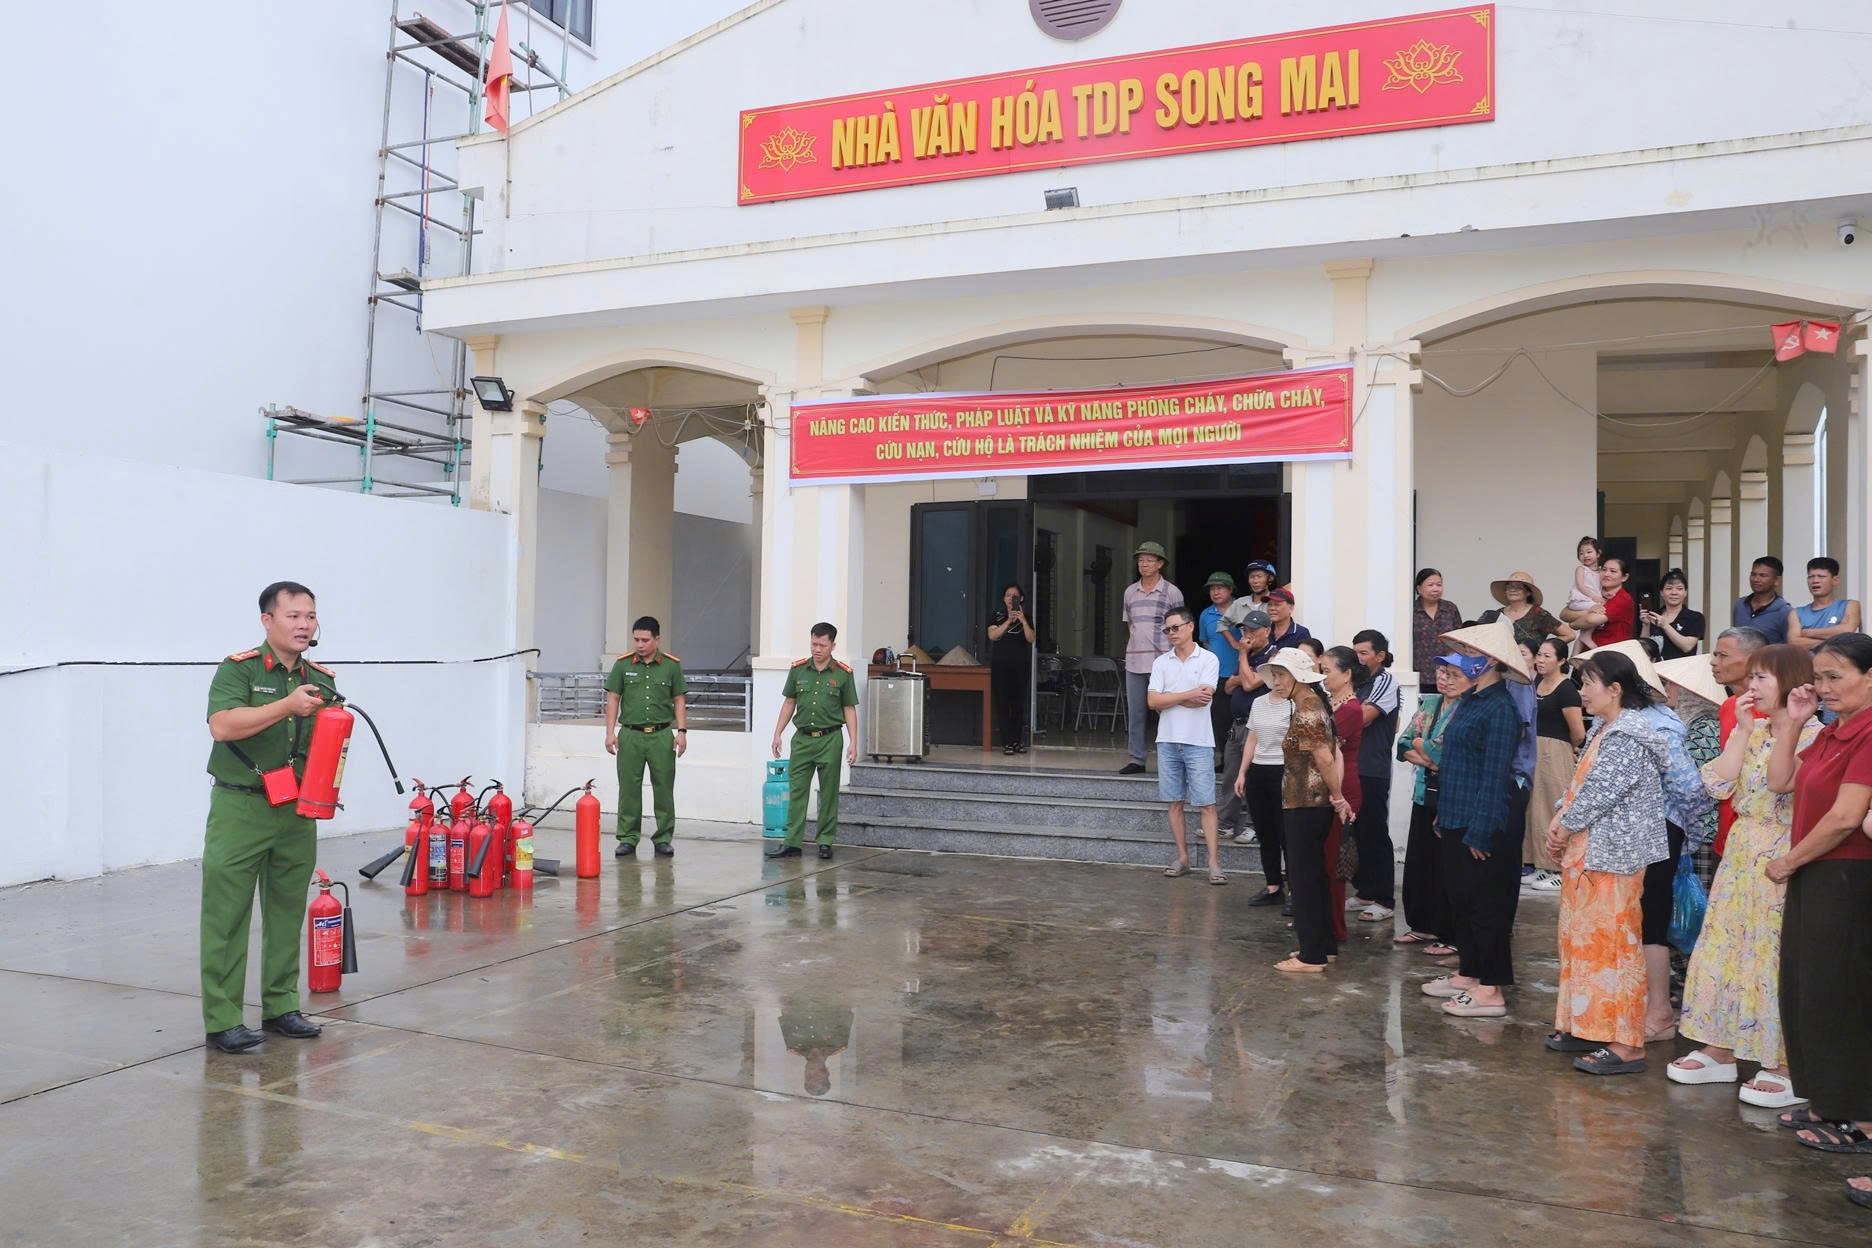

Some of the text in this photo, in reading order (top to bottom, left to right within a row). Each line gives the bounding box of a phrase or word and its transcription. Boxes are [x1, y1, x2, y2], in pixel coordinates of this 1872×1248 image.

[831, 49, 1360, 170] NHÀ VĂN HÓA TDP SONG MAI
[809, 416, 845, 436] NÂNG
[849, 417, 875, 434] CAO
[878, 411, 909, 432] KIẾN
[914, 410, 952, 431] THỨC,
[956, 406, 992, 428] PHÁP
[997, 405, 1031, 428] LUẬT
[1034, 403, 1054, 423] VÀ
[1058, 402, 1075, 422] KỸ
[1127, 395, 1179, 418] PHÒNG
[1184, 391, 1227, 415] CHÁY,
[1232, 388, 1275, 411] CHỮA
[1279, 385, 1325, 409] CHÁY,
[876, 420, 1242, 462] CỨU NẠN, CỨU HỘ LÀ TRÁCH NHIỆM CỦA MỌI NGƯỜI
